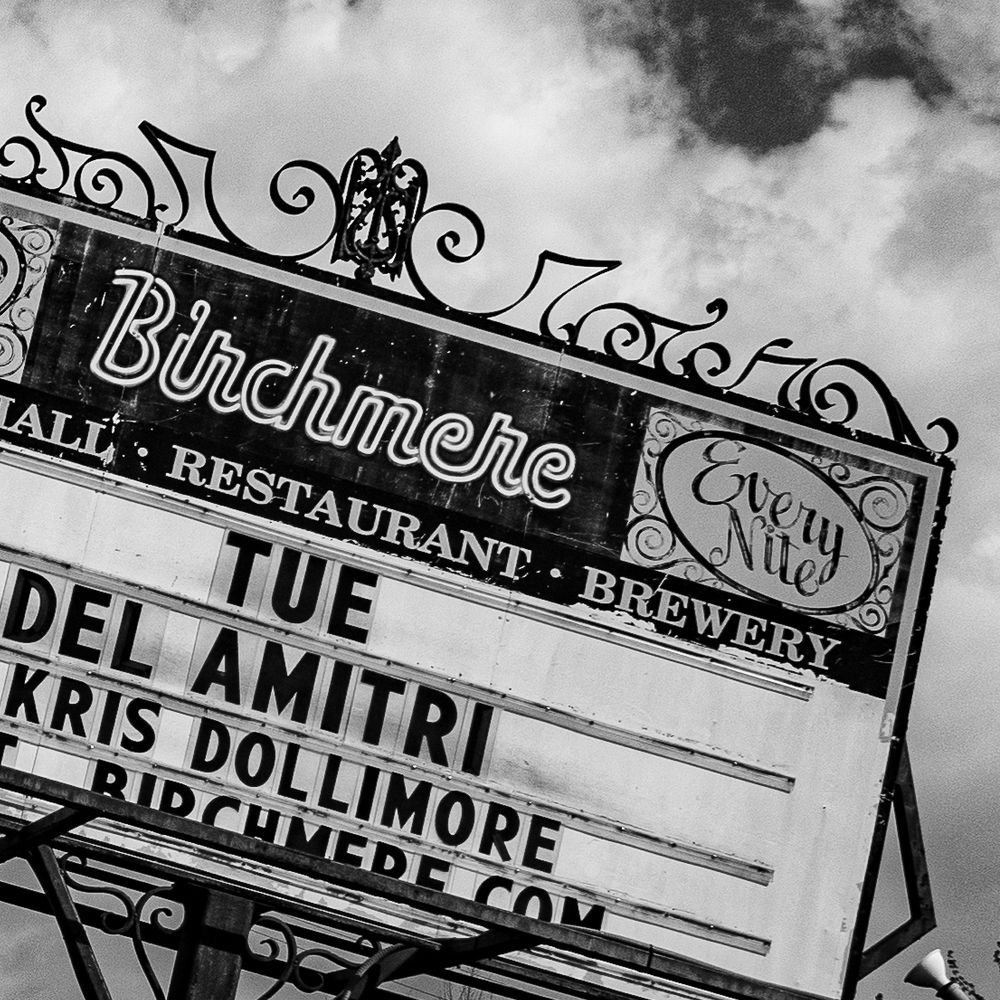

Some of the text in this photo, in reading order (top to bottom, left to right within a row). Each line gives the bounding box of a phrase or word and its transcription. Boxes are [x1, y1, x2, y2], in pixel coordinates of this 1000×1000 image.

[90, 269, 577, 510] Birchmere
[165, 445, 532, 580] RESTAURANT
[578, 565, 842, 670] BREWERY
[226, 531, 380, 645] TUE
[691, 439, 848, 586] Every
[709, 506, 820, 597] Nite
[2, 568, 495, 776] DEL AMITRI
[4, 663, 561, 874] KRIS DOLLIMORE
